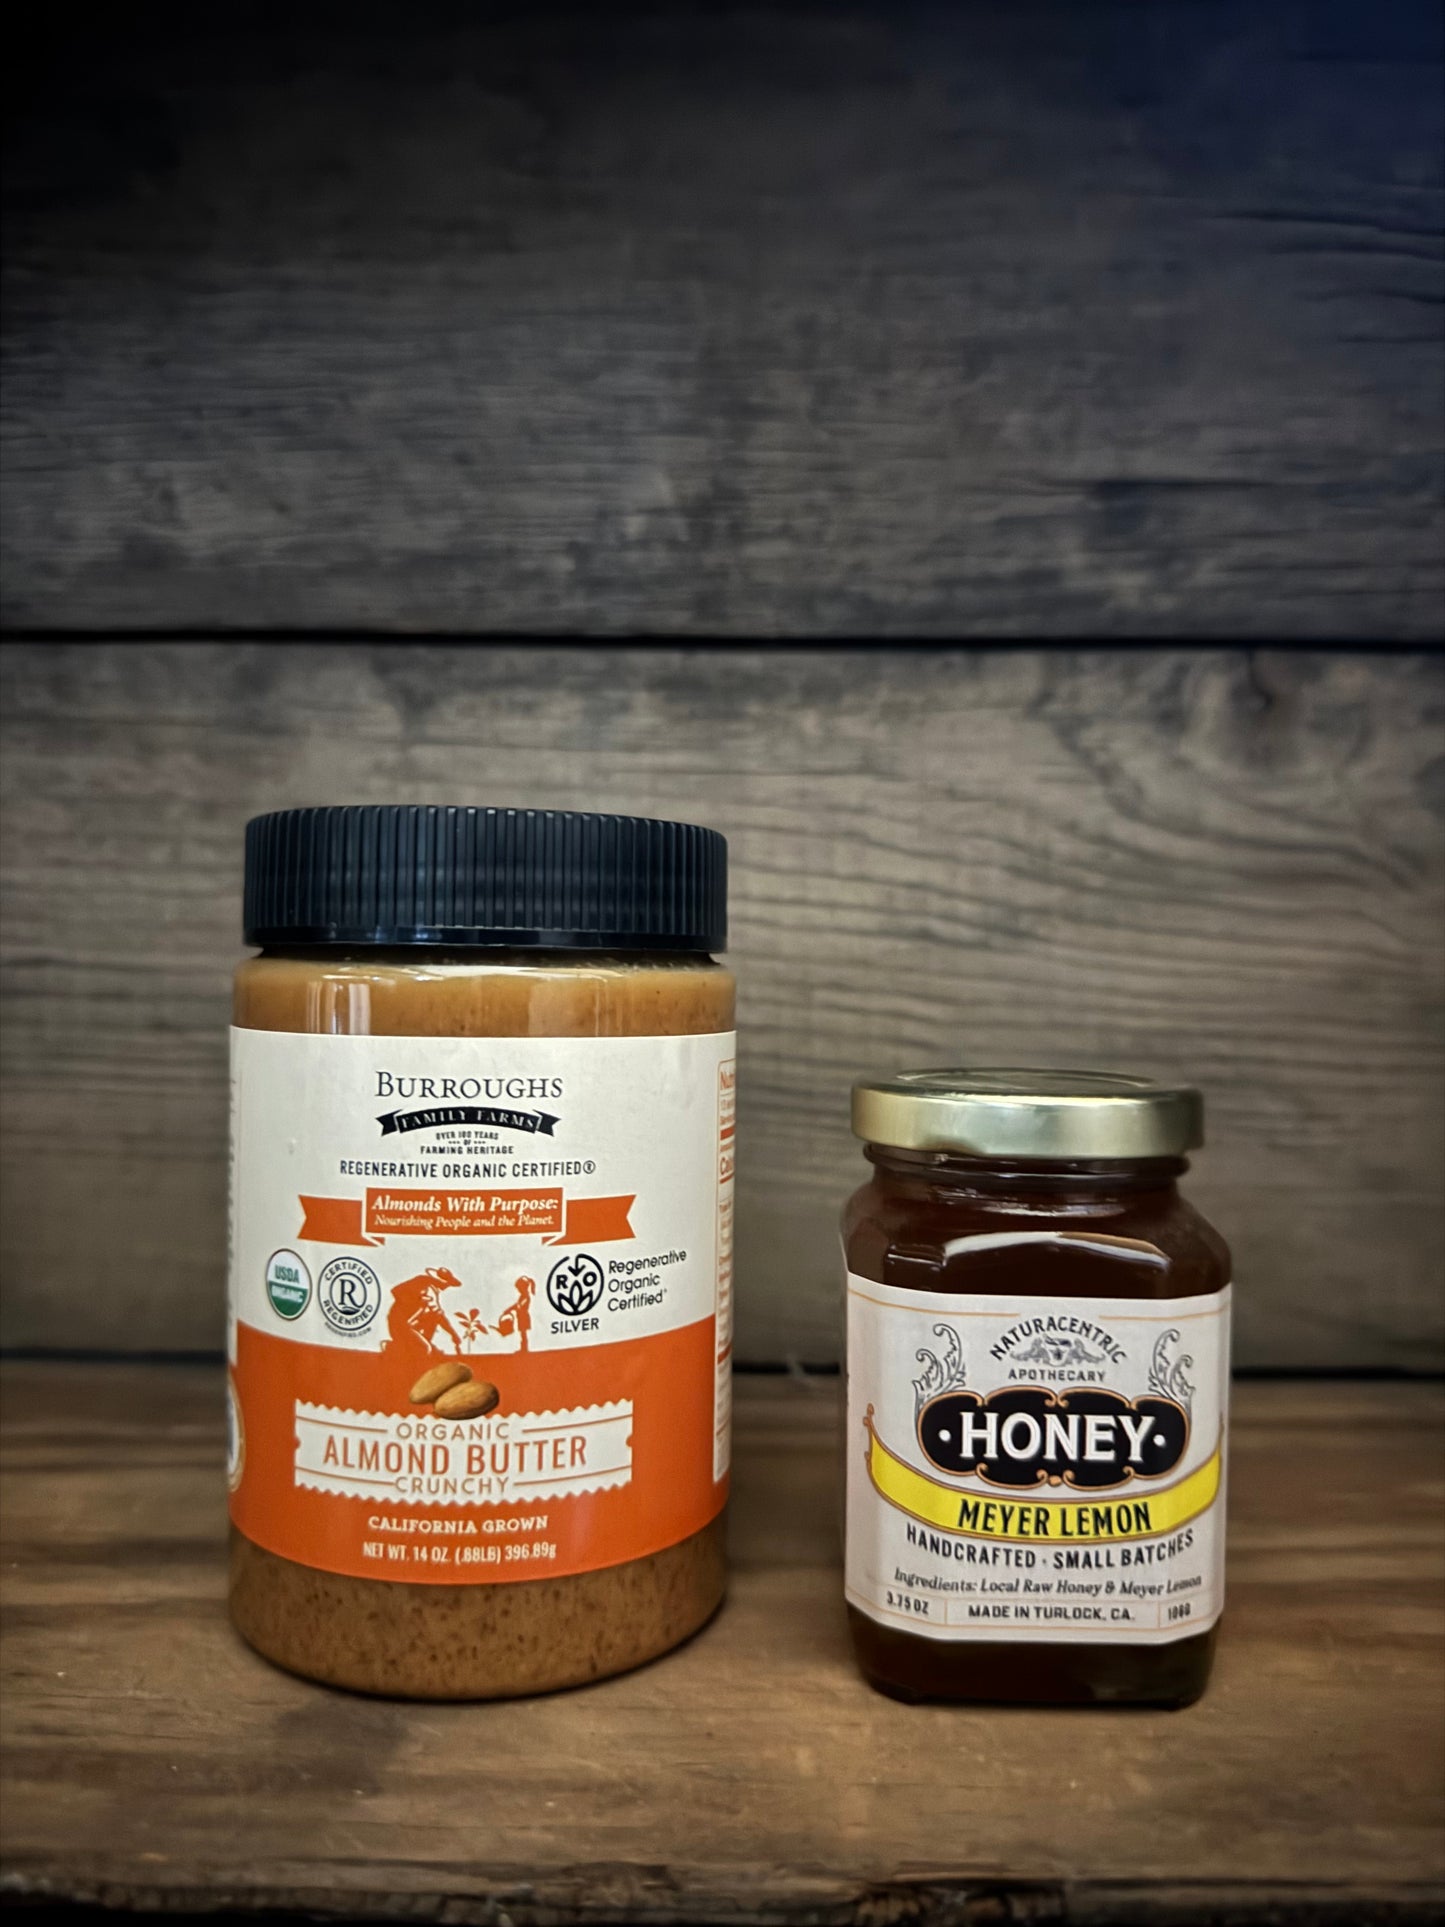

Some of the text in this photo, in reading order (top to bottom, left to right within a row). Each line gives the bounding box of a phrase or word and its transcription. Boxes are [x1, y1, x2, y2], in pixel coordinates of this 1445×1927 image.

[402, 1109, 536, 1129] FAMILY FARMS
[436, 1130, 499, 1140] OVER 100 YEARS
[420, 1146, 514, 1155] FARMING HERITAGE
[340, 1160, 438, 1177] REGENERATIVE
[442, 1162, 507, 1178] ORGANIC
[372, 1195, 442, 1211] Almonds
[447, 1197, 485, 1212] With
[374, 1214, 434, 1229] Nourishing
[435, 1215, 471, 1230] People
[473, 1215, 496, 1227] and
[498, 1215, 514, 1226] the
[608, 1250, 687, 1275] Regenerative
[275, 1265, 300, 1283] USDA
[324, 1261, 374, 1285] CERTIFIED
[338, 1278, 363, 1308] R
[608, 1273, 660, 1294] Organic
[323, 1299, 374, 1326] REGENIFIED
[551, 1317, 600, 1334] SILVER
[990, 1316, 1127, 1364] NATURACENTRIC
[1008, 1368, 1106, 1382] APOTHECARY
[396, 1422, 510, 1441] ORGANIC
[959, 1411, 1157, 1463] HONEY
[323, 1435, 587, 1475] ALMOND BUTTER
[395, 1476, 509, 1495] CRUNCHY
[368, 1516, 548, 1534] CALIFORNIA GROWN
[957, 1499, 1152, 1537] MEYER LEMON
[363, 1541, 384, 1557] NET
[413, 1546, 428, 1563] 14
[906, 1523, 1194, 1570] HANDCRAFTED SMALL BATCHES
[894, 1567, 1202, 1598] Ingredients: Local Raw Honey & Meyer Lemon
[968, 1605, 1010, 1618] MADE
[1014, 1605, 1030, 1618] IN
